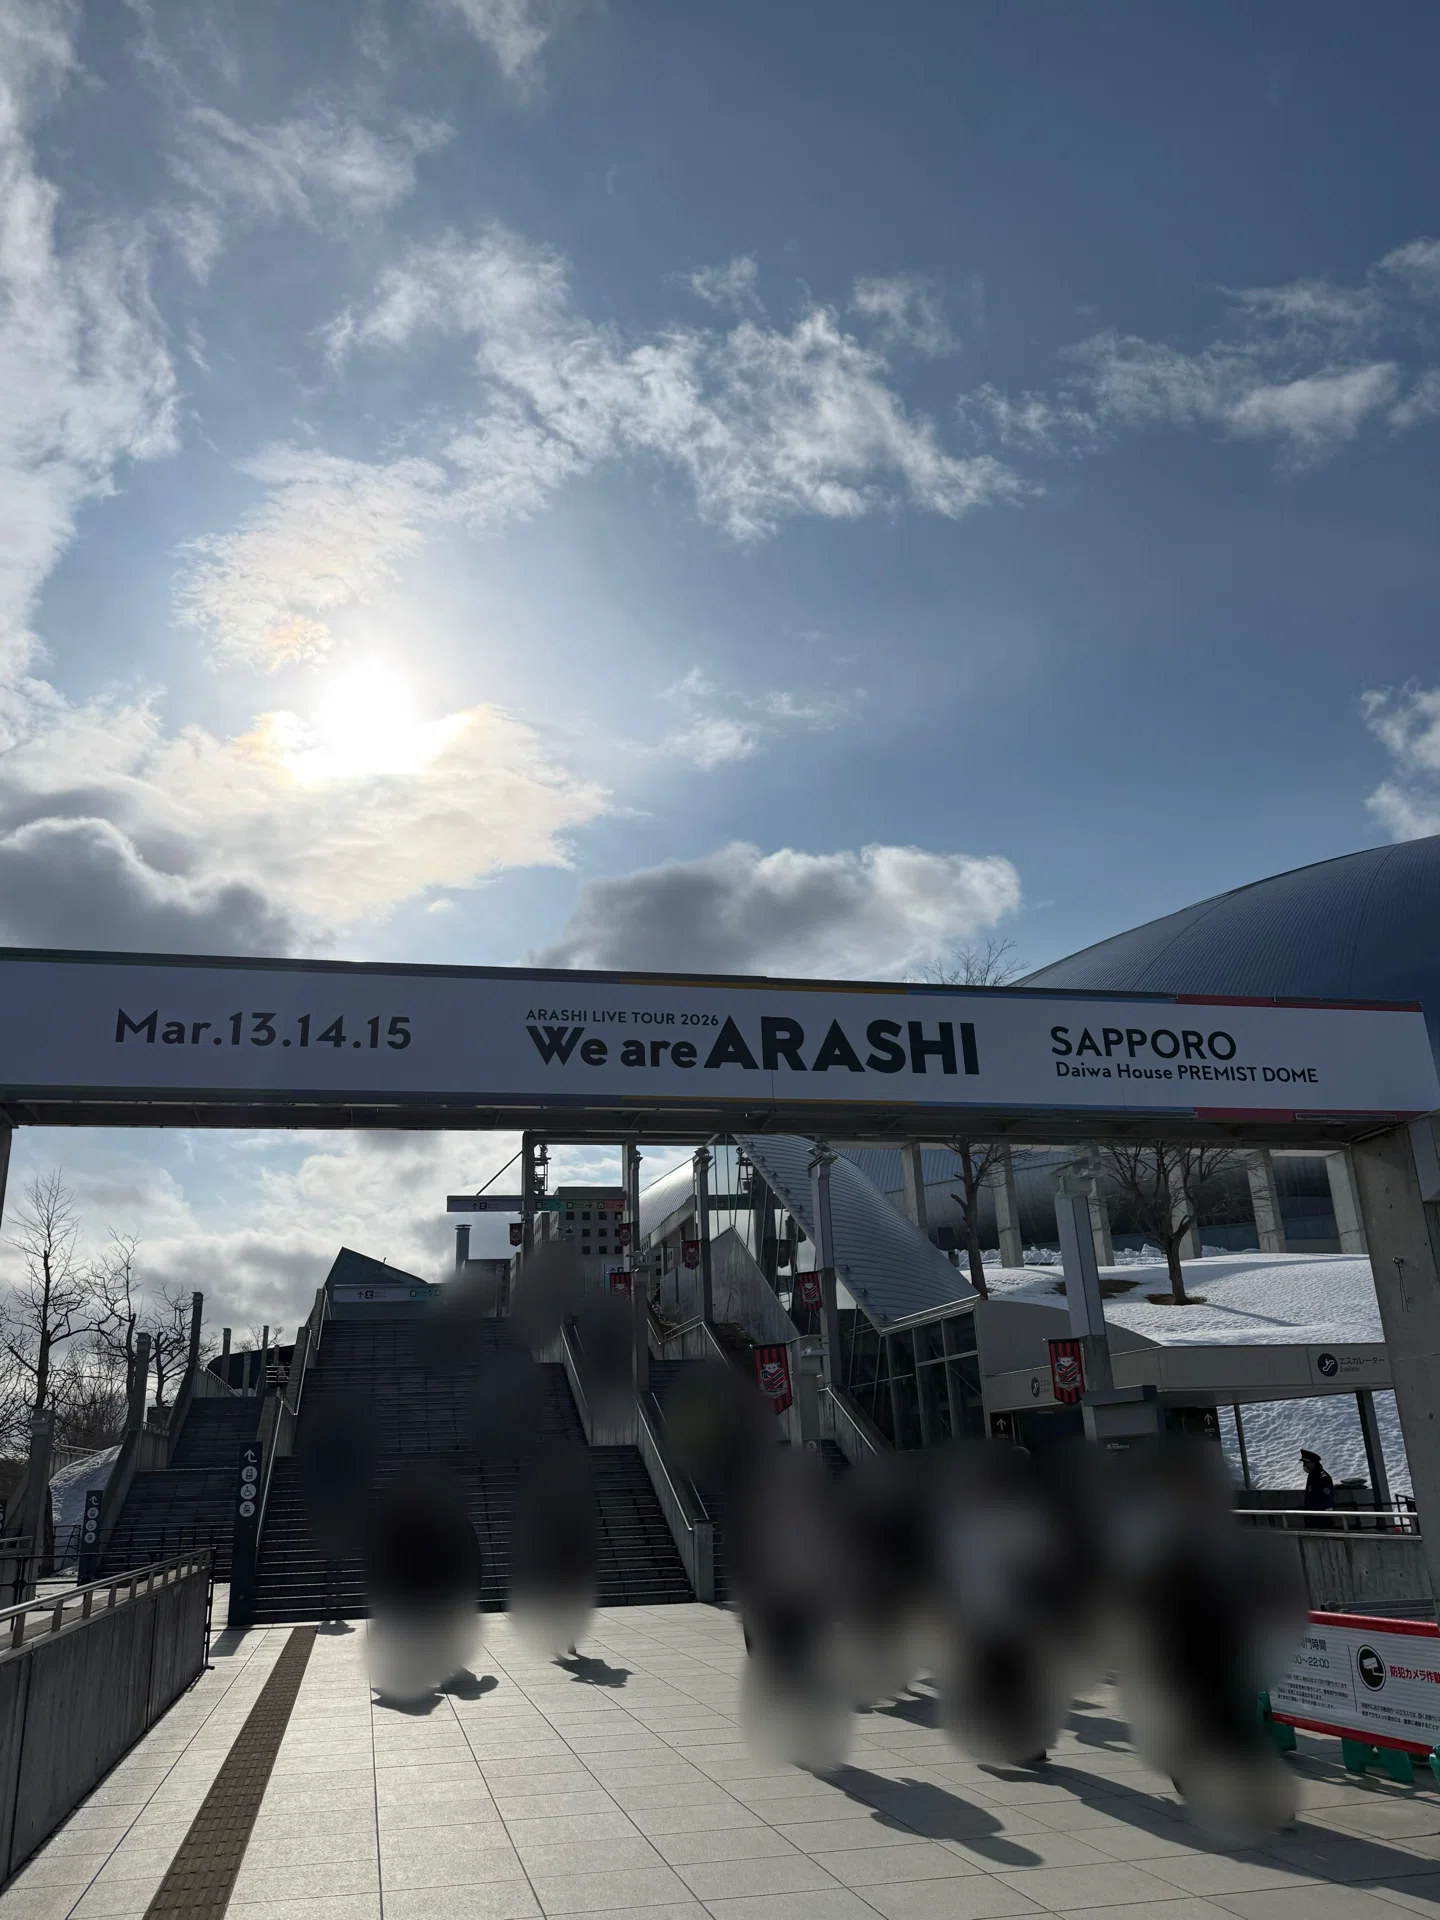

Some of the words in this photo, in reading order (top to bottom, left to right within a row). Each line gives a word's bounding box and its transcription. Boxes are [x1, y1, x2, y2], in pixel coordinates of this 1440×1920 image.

[115, 1008, 412, 1050] Mar.13.14.15
[526, 1008, 588, 1022] ARASHI
[592, 1011, 627, 1023] LIVE
[632, 1012, 676, 1025] TOUR
[680, 1014, 719, 1026] 2026
[526, 1025, 608, 1067] We
[620, 1038, 698, 1069] are
[703, 1014, 980, 1075] ARASHI
[1050, 1025, 1237, 1061] SAPPORO
[1056, 1061, 1112, 1078] Daiwa
[1117, 1063, 1173, 1080] House
[1178, 1064, 1258, 1082] PREMIST
[1263, 1066, 1319, 1083] DOME
[1339, 1357, 1385, 1365] エスカレーター
